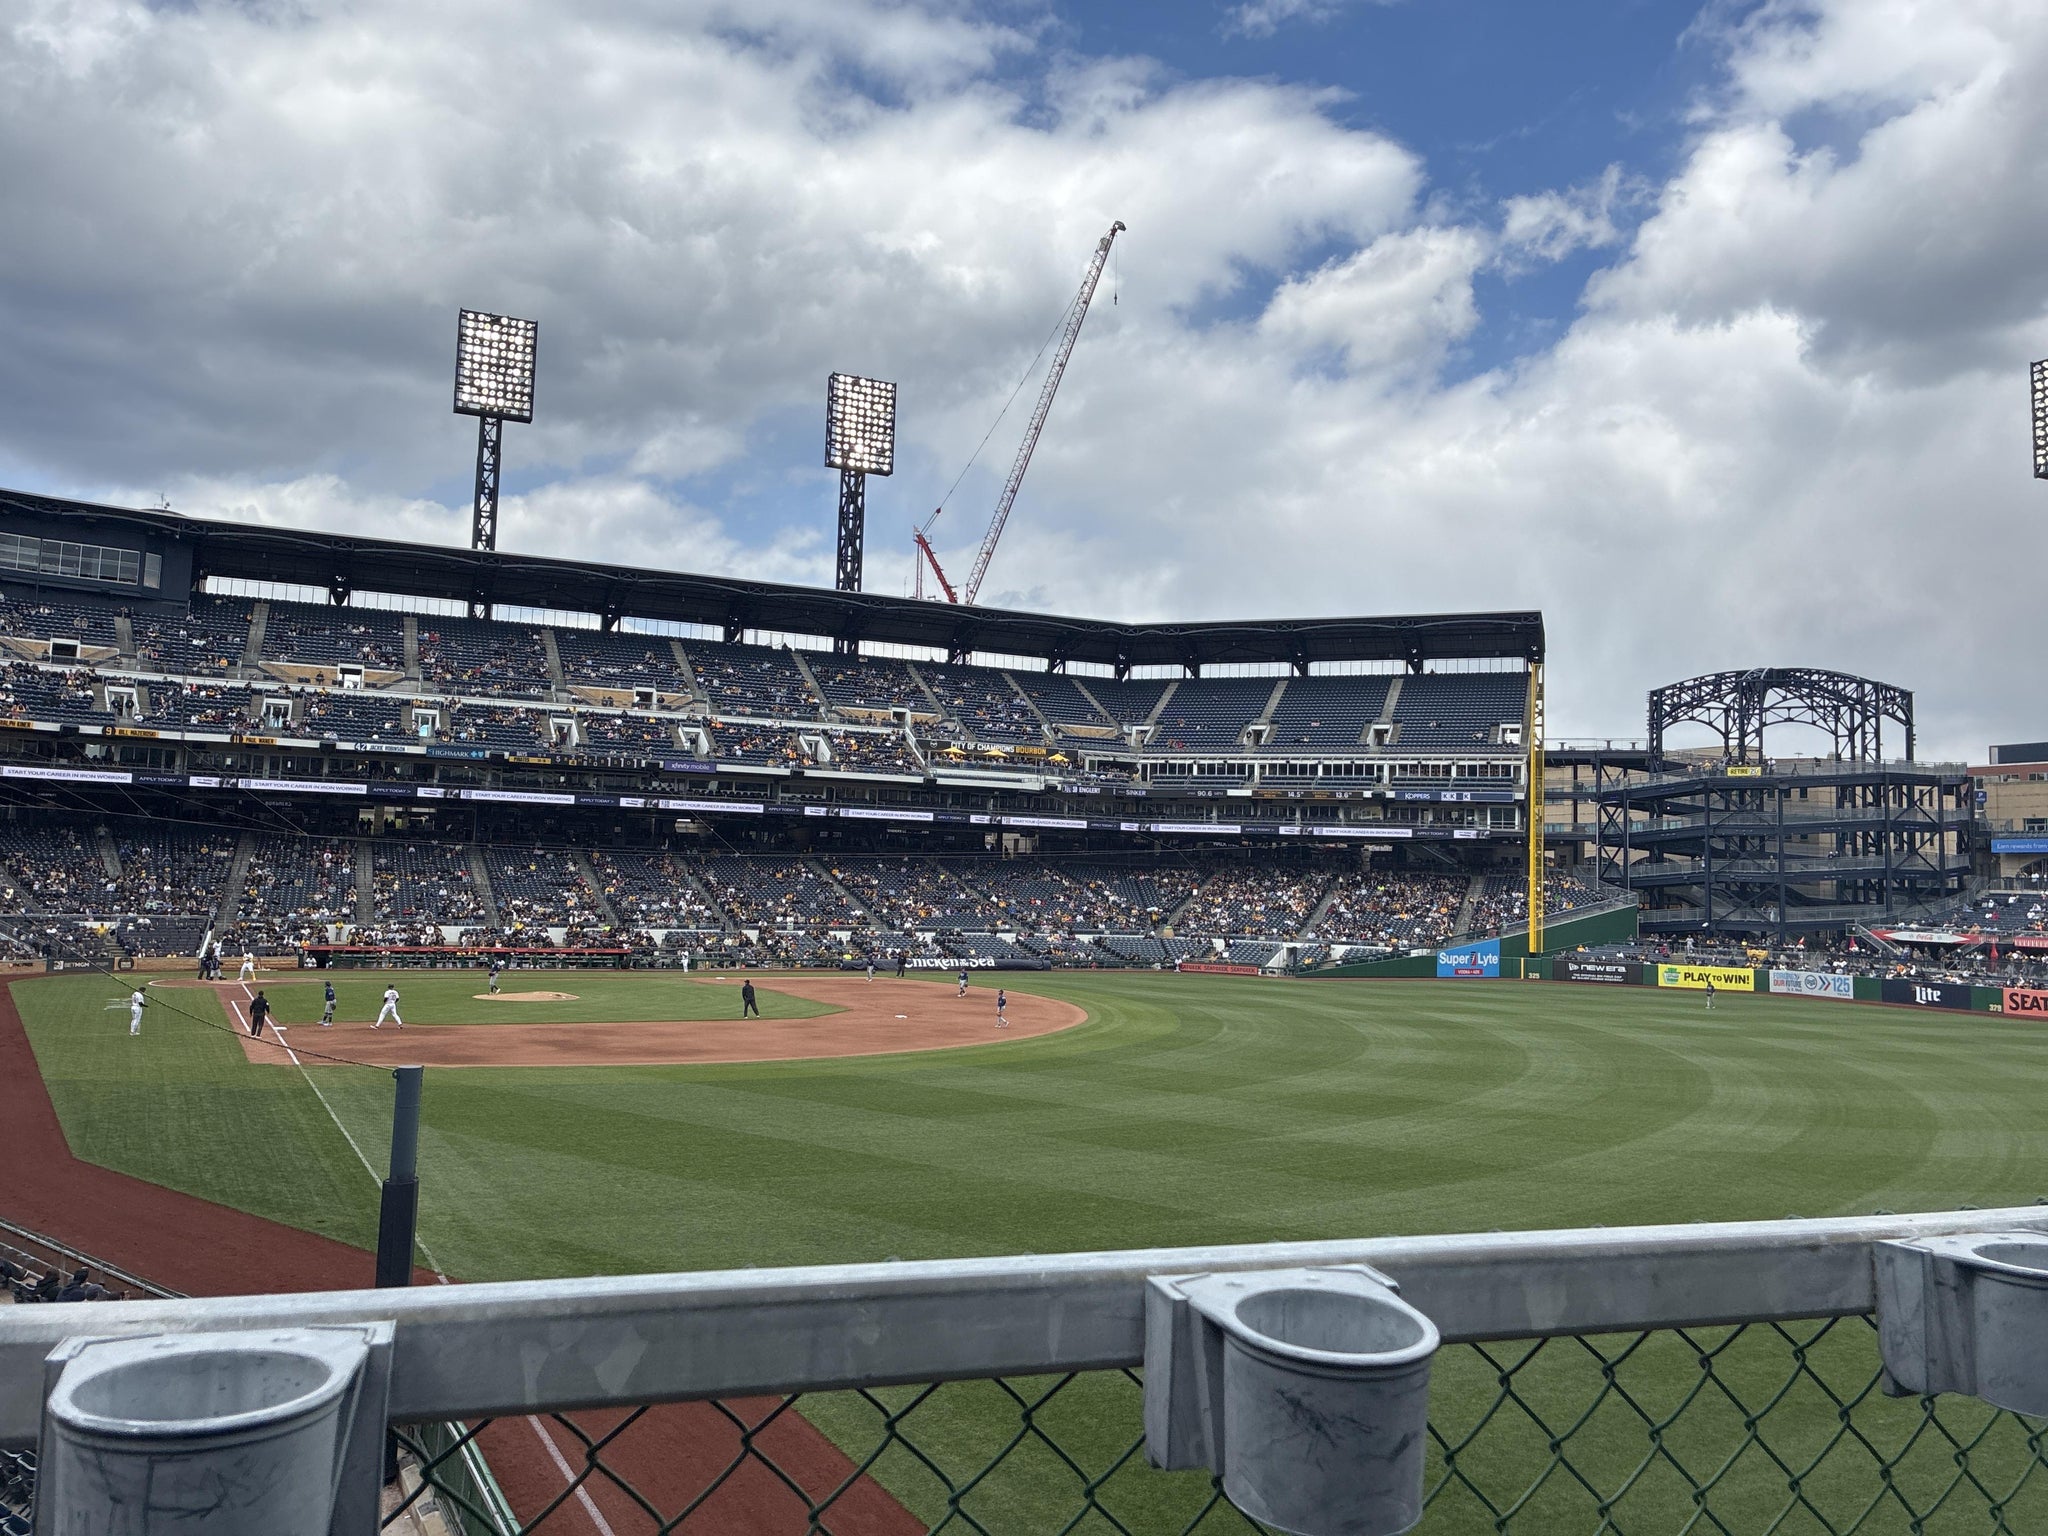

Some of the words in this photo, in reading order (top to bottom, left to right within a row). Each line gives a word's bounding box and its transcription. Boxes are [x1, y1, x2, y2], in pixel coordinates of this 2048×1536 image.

[106, 727, 112, 735] 9
[432, 750, 469, 758] HIGHMARK
[978, 744, 1014, 752] CHAMPIONS
[1016, 746, 1046, 755] BOURBON
[607, 758, 611, 767] 1
[620, 758, 624, 767] 1
[633, 758, 637, 768] 1
[671, 762, 691, 770] xfinity
[904, 958, 960, 970] Chicken
[969, 958, 995, 967] Sea
[1440, 952, 1469, 966] Super
[1477, 953, 1498, 966] Lyte
[1684, 972, 1711, 982] PLAY
[1723, 974, 1750, 984] WIN!
[1831, 976, 1850, 992] 125
[1915, 987, 1941, 1004] Lite
[2009, 992, 2048, 1011] SEAT
